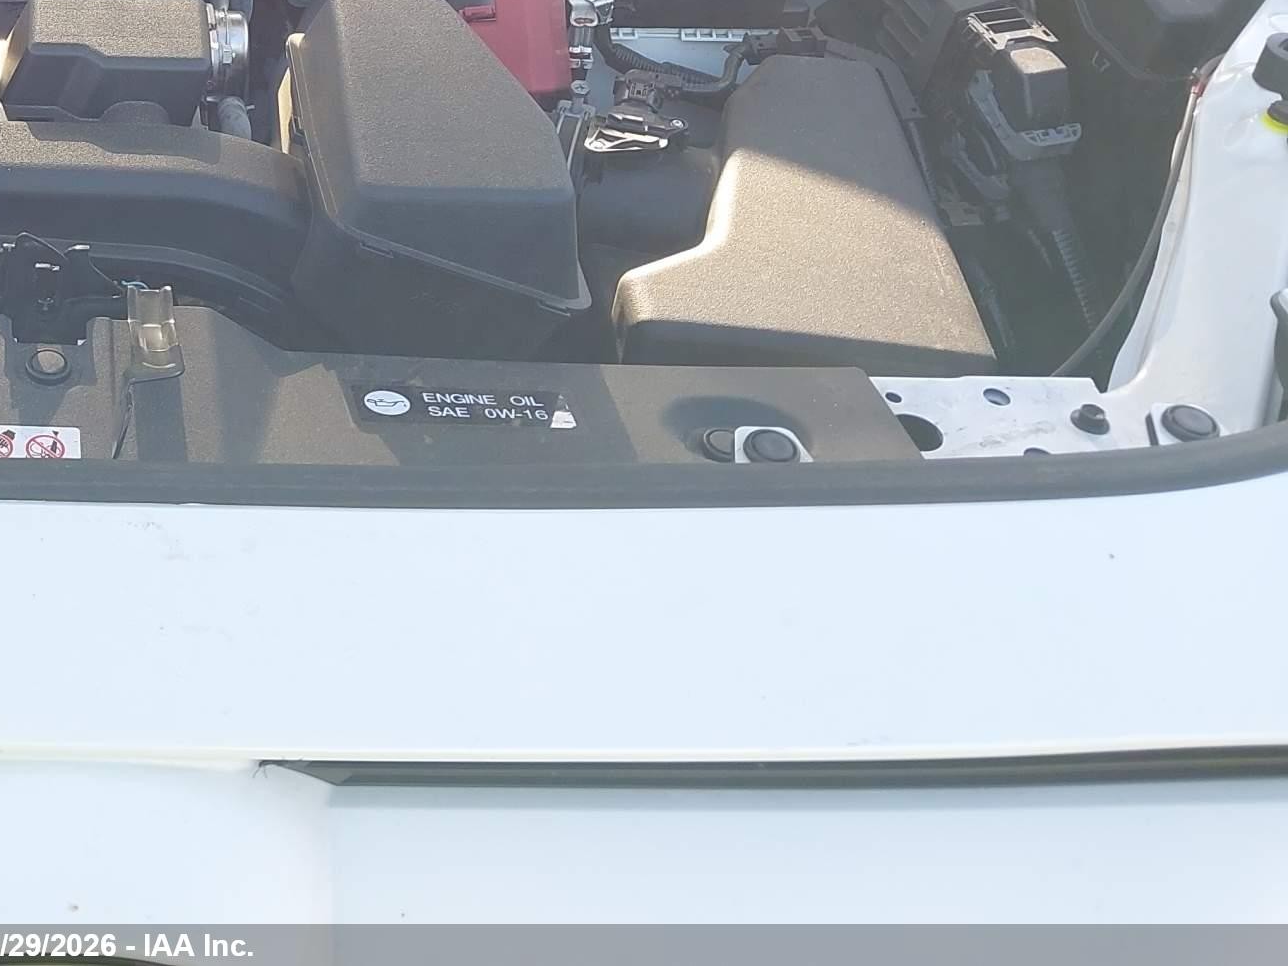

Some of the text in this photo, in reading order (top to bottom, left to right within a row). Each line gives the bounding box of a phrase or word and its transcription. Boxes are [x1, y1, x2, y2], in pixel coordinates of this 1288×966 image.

[422, 391, 545, 407] ENGINE OIL
[428, 406, 549, 421] SAE 0W-16
